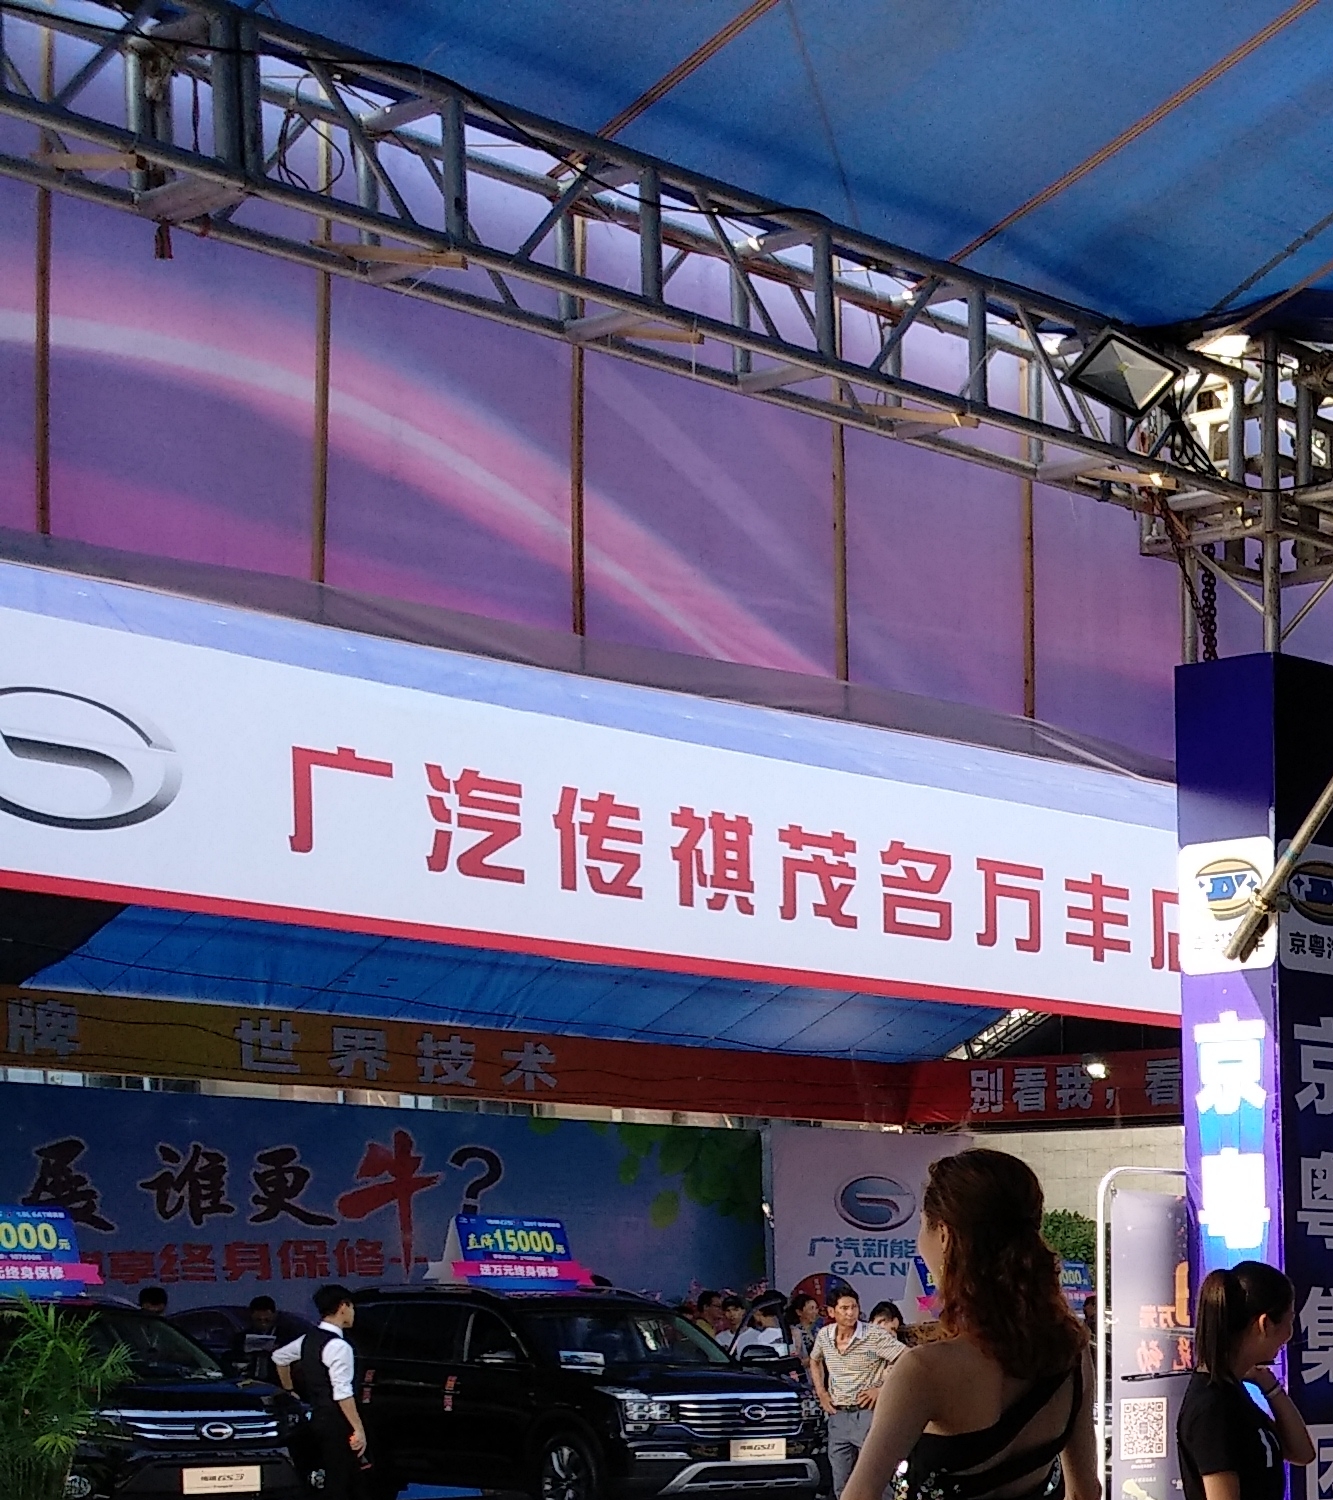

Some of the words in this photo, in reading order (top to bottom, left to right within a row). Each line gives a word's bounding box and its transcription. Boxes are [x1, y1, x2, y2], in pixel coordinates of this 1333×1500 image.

[233, 1017, 560, 1091] 世界技术
[807, 1236, 917, 1259] 广汽新能
[830, 1261, 886, 1276] GAC
